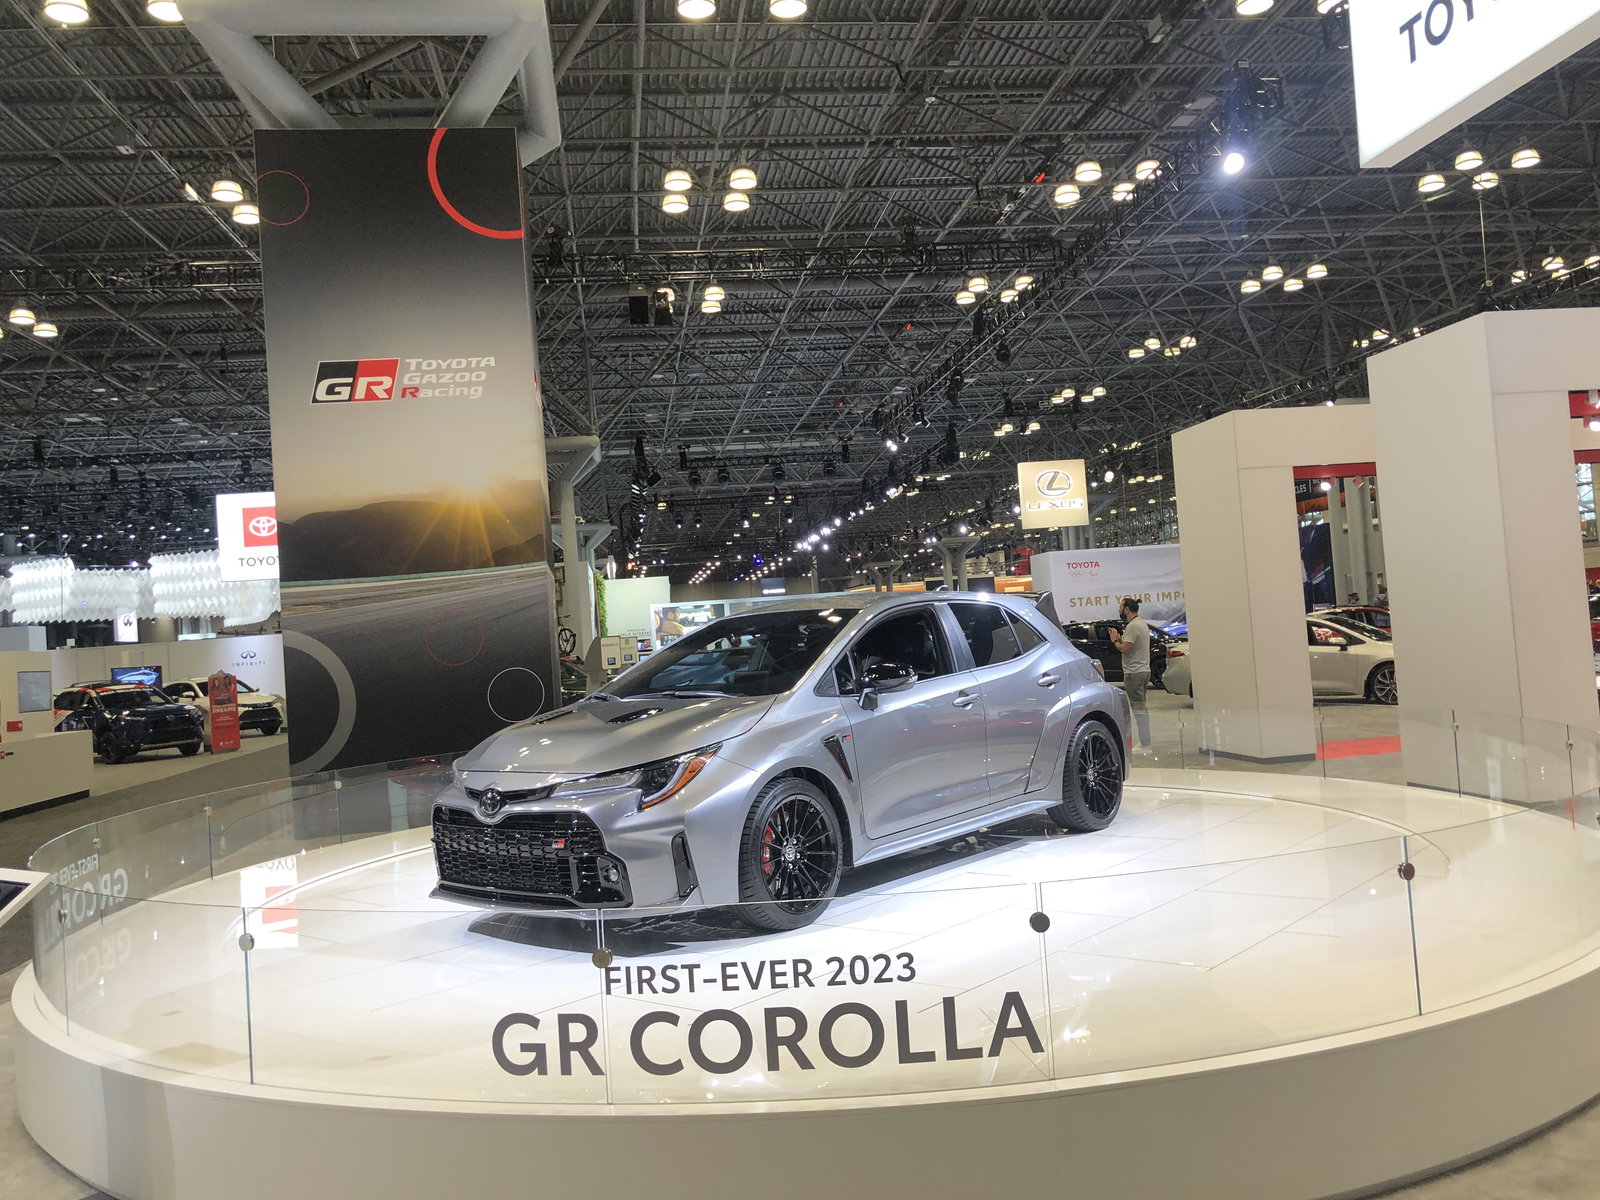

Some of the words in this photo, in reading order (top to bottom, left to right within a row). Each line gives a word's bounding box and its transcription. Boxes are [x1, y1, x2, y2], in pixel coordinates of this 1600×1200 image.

[405, 356, 496, 371] TOYOTA
[403, 371, 487, 385] GAZOO
[315, 376, 393, 401] GR
[400, 385, 483, 399] Racing
[238, 556, 279, 567] TOYO
[1066, 561, 1100, 570] TOYOTA
[1069, 596, 1110, 608] START
[1156, 591, 1184, 602] IMP
[604, 959, 816, 995] FIRST-EVER
[826, 951, 917, 987] 2023
[491, 1011, 606, 1077] GR
[629, 990, 1045, 1076] COROLLA
